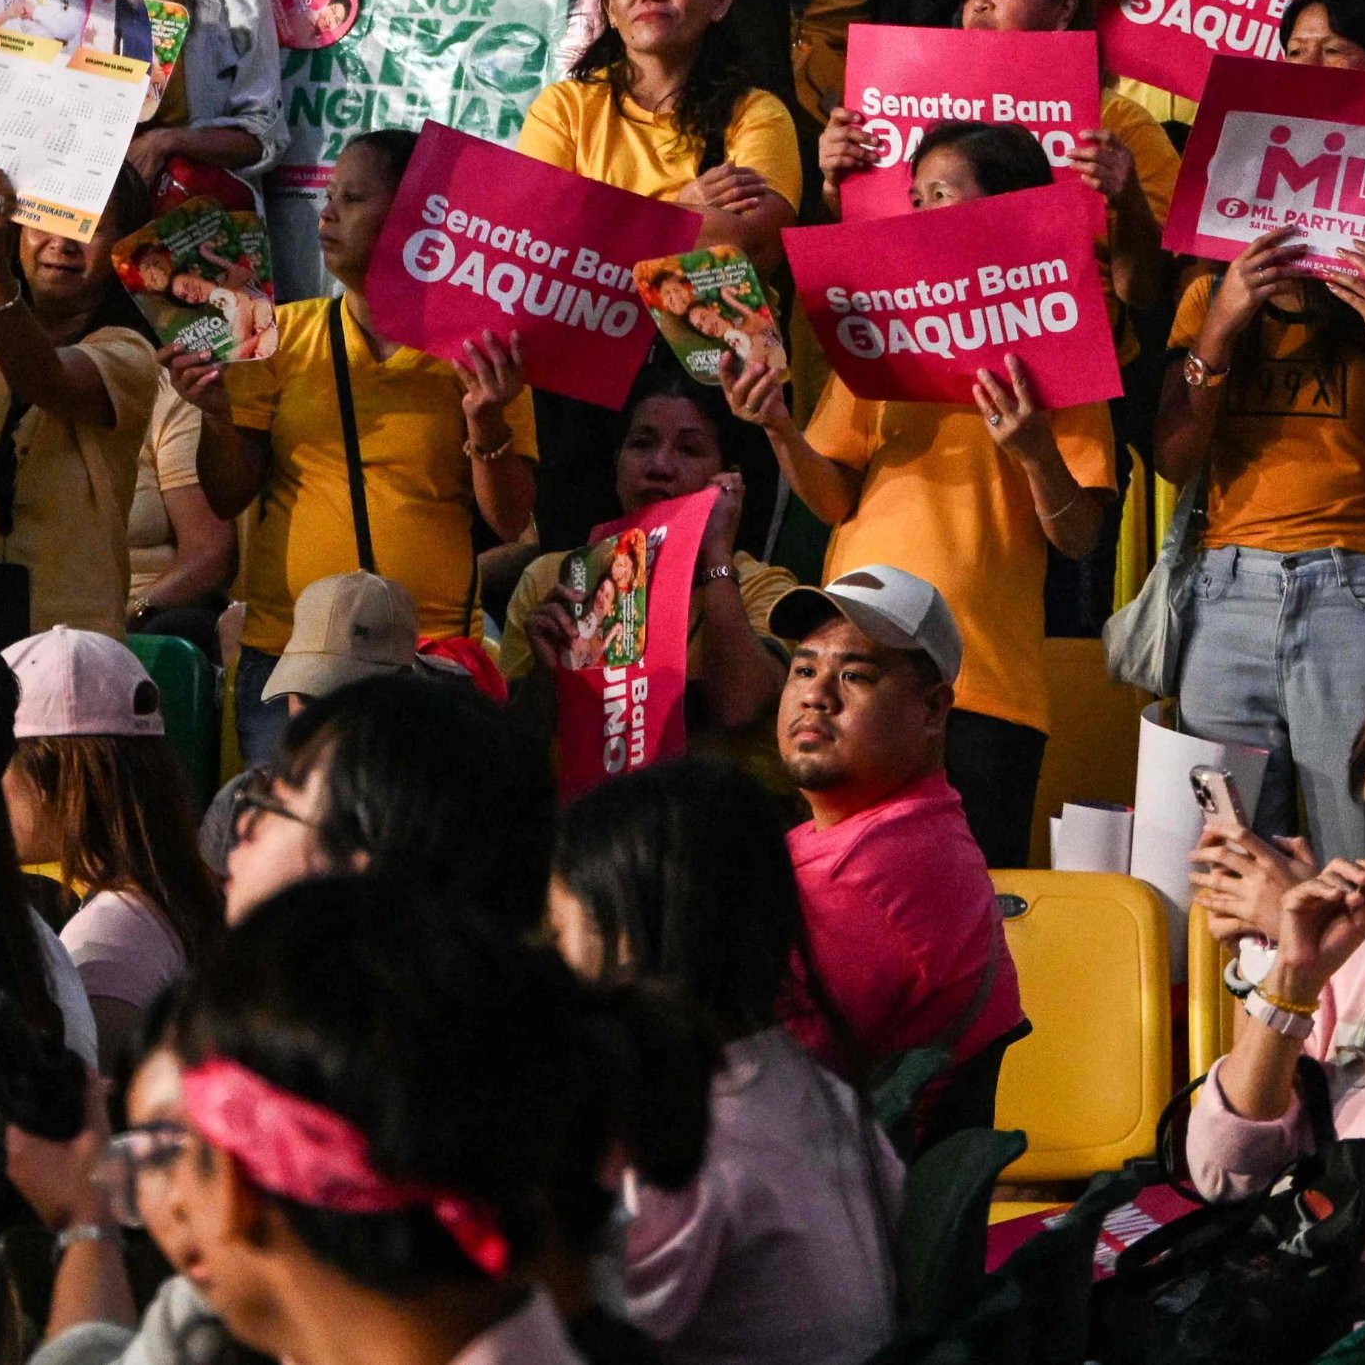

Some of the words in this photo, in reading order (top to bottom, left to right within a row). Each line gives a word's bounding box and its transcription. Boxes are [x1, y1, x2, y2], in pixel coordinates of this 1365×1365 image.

[862, 86, 989, 121] Senator
[993, 93, 1072, 123] Bam
[422, 194, 569, 267] Senator
[1255, 204, 1278, 222] ML
[453, 255, 639, 340] AQUINO
[826, 266, 976, 315] Senator
[979, 256, 1069, 300] Bam
[886, 291, 1079, 360] AQUINO
[631, 675, 649, 766] Bam
